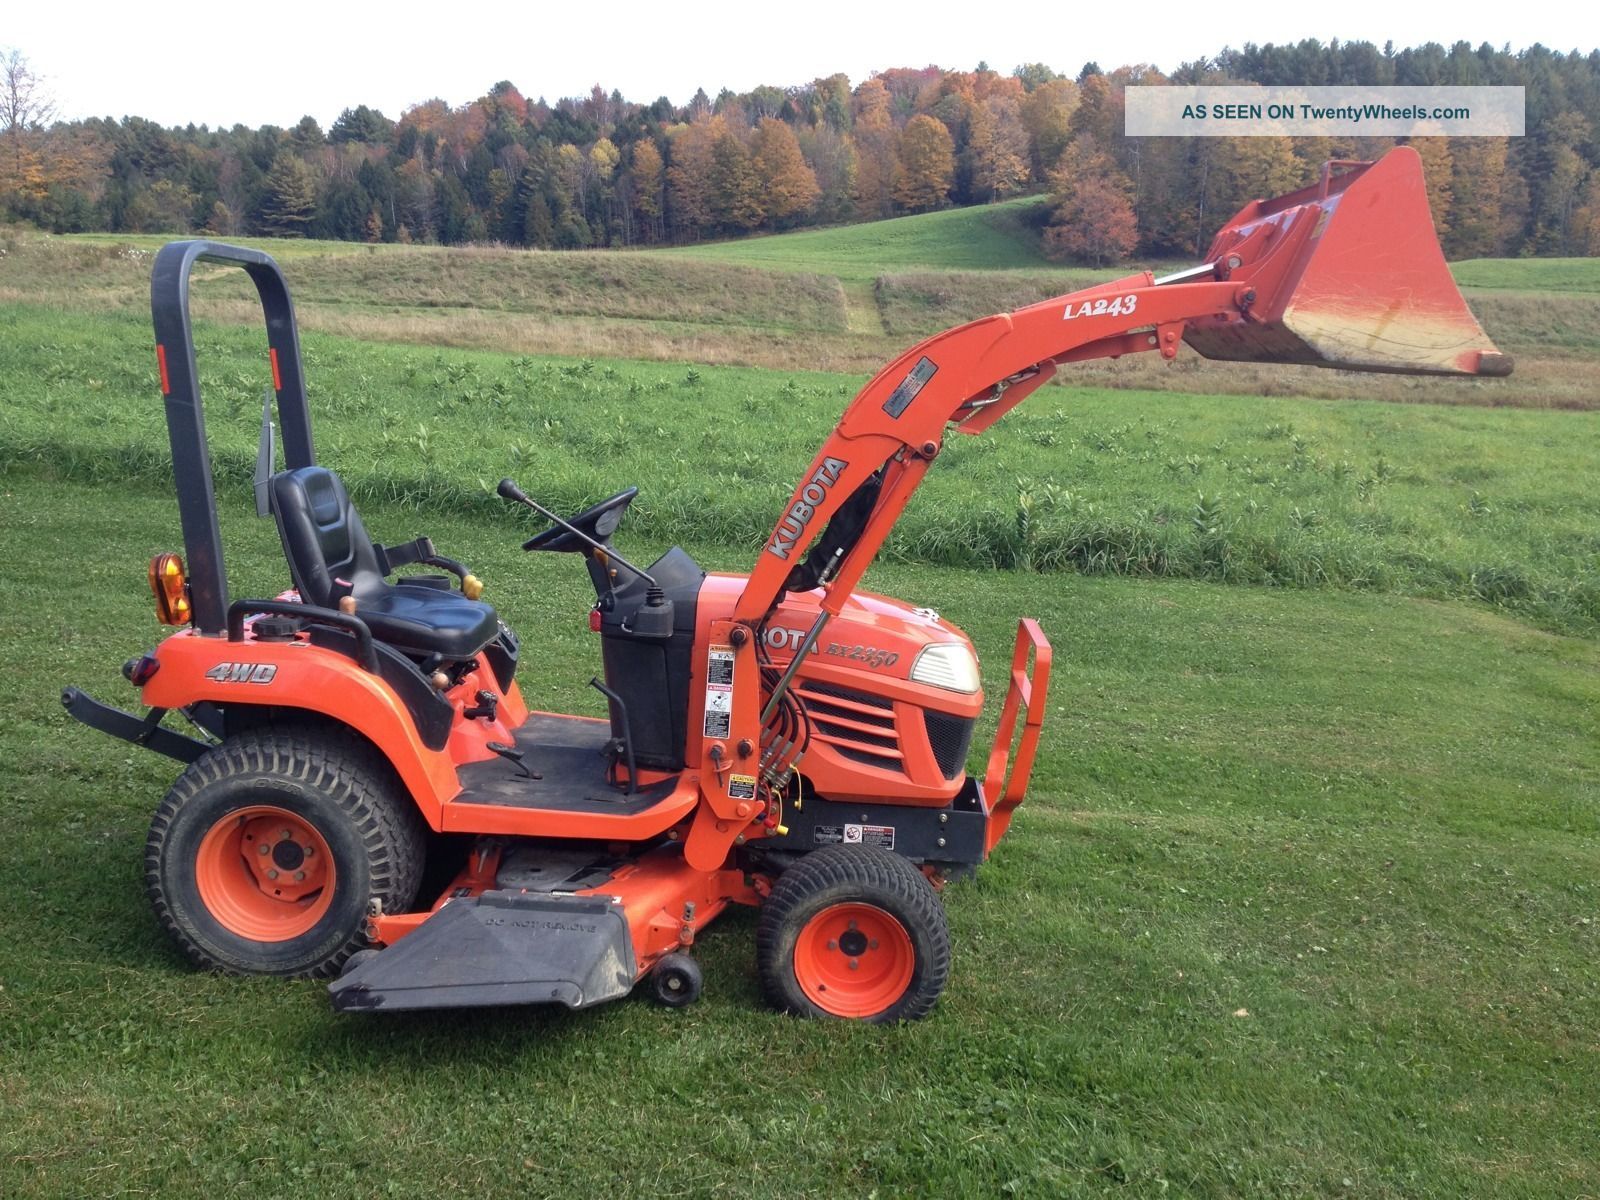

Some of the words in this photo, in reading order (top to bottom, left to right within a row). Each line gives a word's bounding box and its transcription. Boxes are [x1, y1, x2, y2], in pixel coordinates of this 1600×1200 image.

[1063, 295, 1137, 320] LA243
[767, 456, 849, 560] KUBOTA
[205, 662, 278, 684] 4WD
[511, 919, 539, 928] NOT
